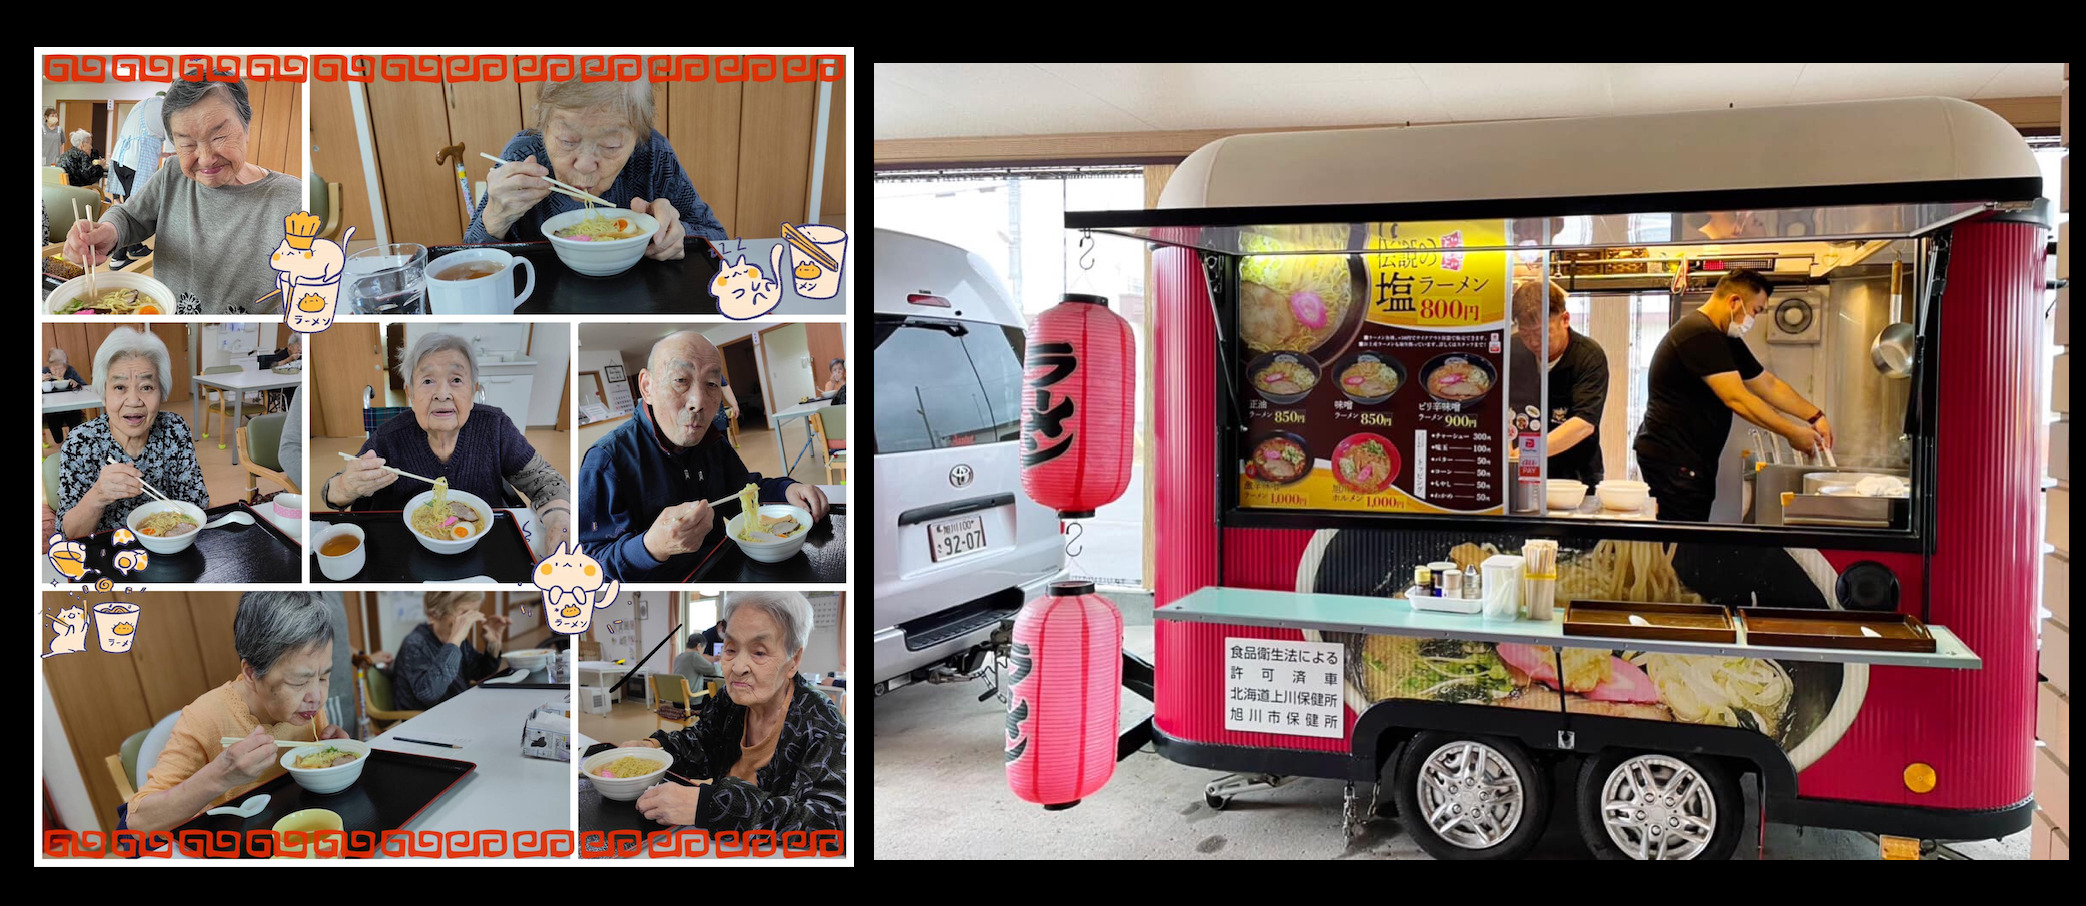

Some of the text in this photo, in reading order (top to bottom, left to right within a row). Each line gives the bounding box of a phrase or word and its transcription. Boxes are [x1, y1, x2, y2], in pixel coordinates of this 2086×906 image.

[1376, 272, 1489, 312] 塩 ラーメン
[1420, 299, 1479, 322] 800円
[1024, 342, 1077, 467] ラーメン
[1249, 411, 1306, 424] ラーメン 850円
[1334, 412, 1392, 426] ラーメン 850円
[1418, 413, 1477, 428] ラーメン 900円
[1473, 444, 1491, 453] 100円
[1476, 456, 1491, 465] 50円
[1476, 469, 1491, 477] 50円
[1476, 481, 1491, 489] 50円
[1270, 493, 1307, 506] 1,000円
[1366, 495, 1405, 509] 1,000円
[1476, 493, 1490, 502] 50円
[944, 530, 981, 556] 92-07
[1230, 645, 1338, 665] 食品衛生法による
[1230, 686, 1338, 708] 北海道上川保健所
[1230, 707, 1338, 729] 旭川市保健所
